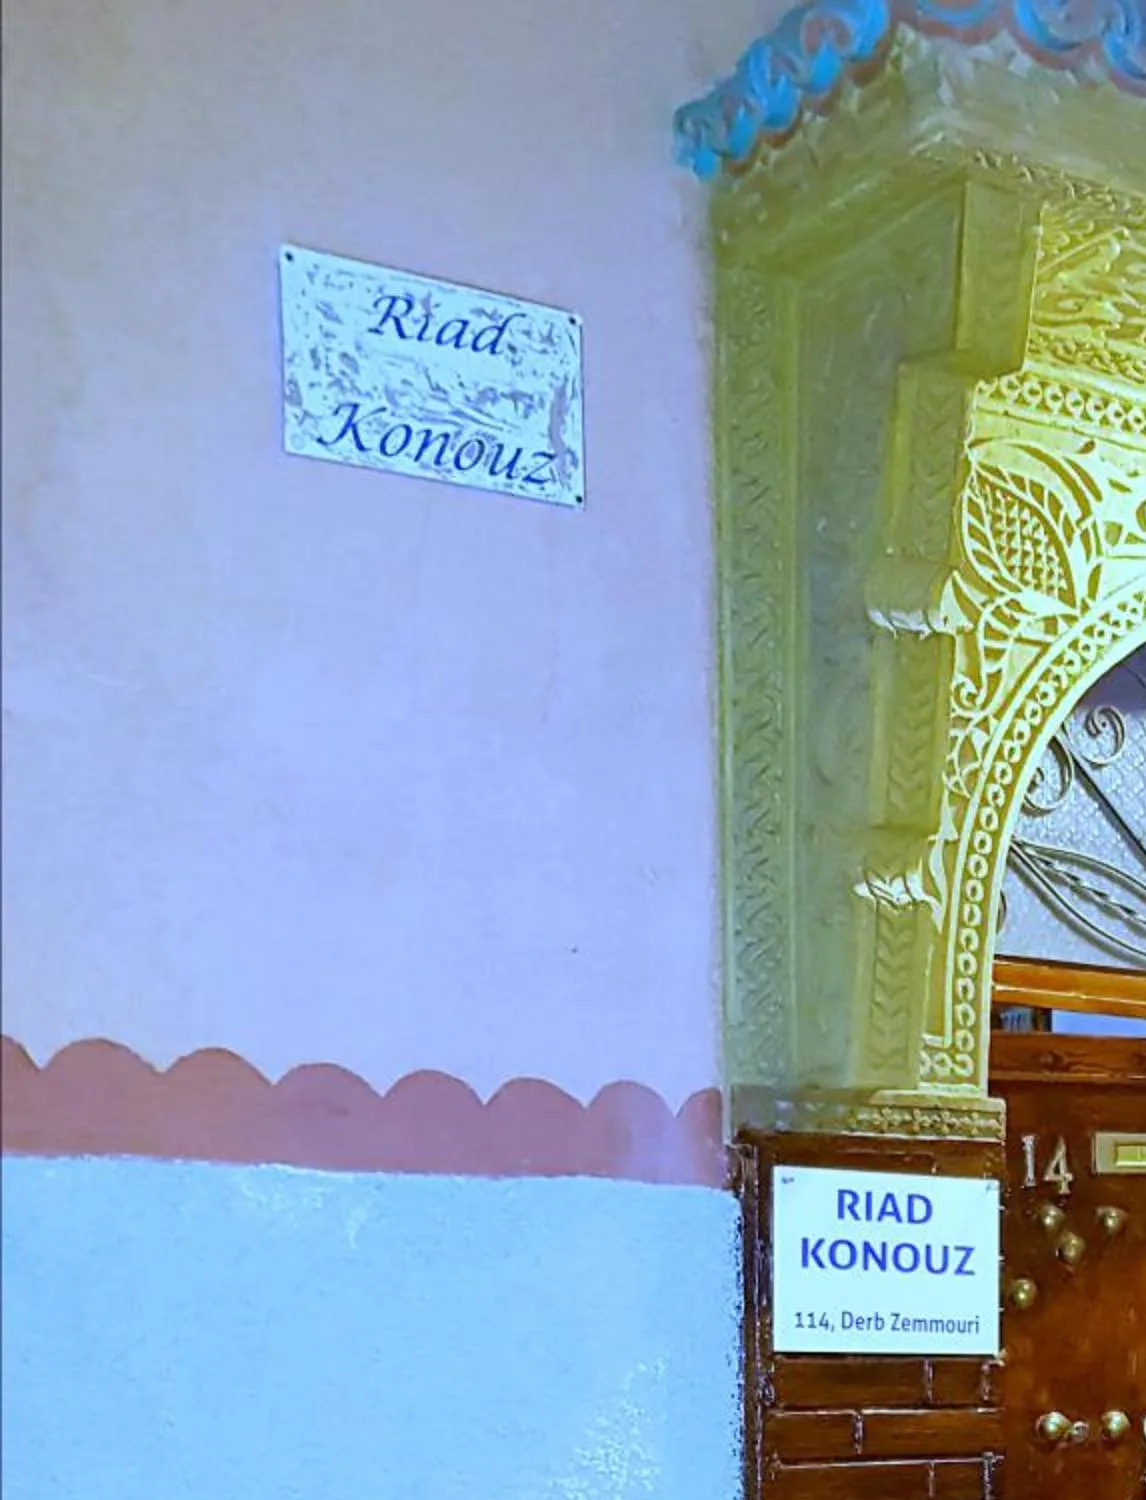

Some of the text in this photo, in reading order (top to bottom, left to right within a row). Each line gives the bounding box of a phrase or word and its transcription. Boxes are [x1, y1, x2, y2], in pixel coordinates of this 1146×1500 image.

[367, 294, 526, 356] Riad
[316, 402, 558, 485] Konouz
[836, 1188, 933, 1225] RIAD
[801, 1237, 977, 1276] KONOUZ
[795, 1311, 980, 1334] 114, Derb Zemmouri
